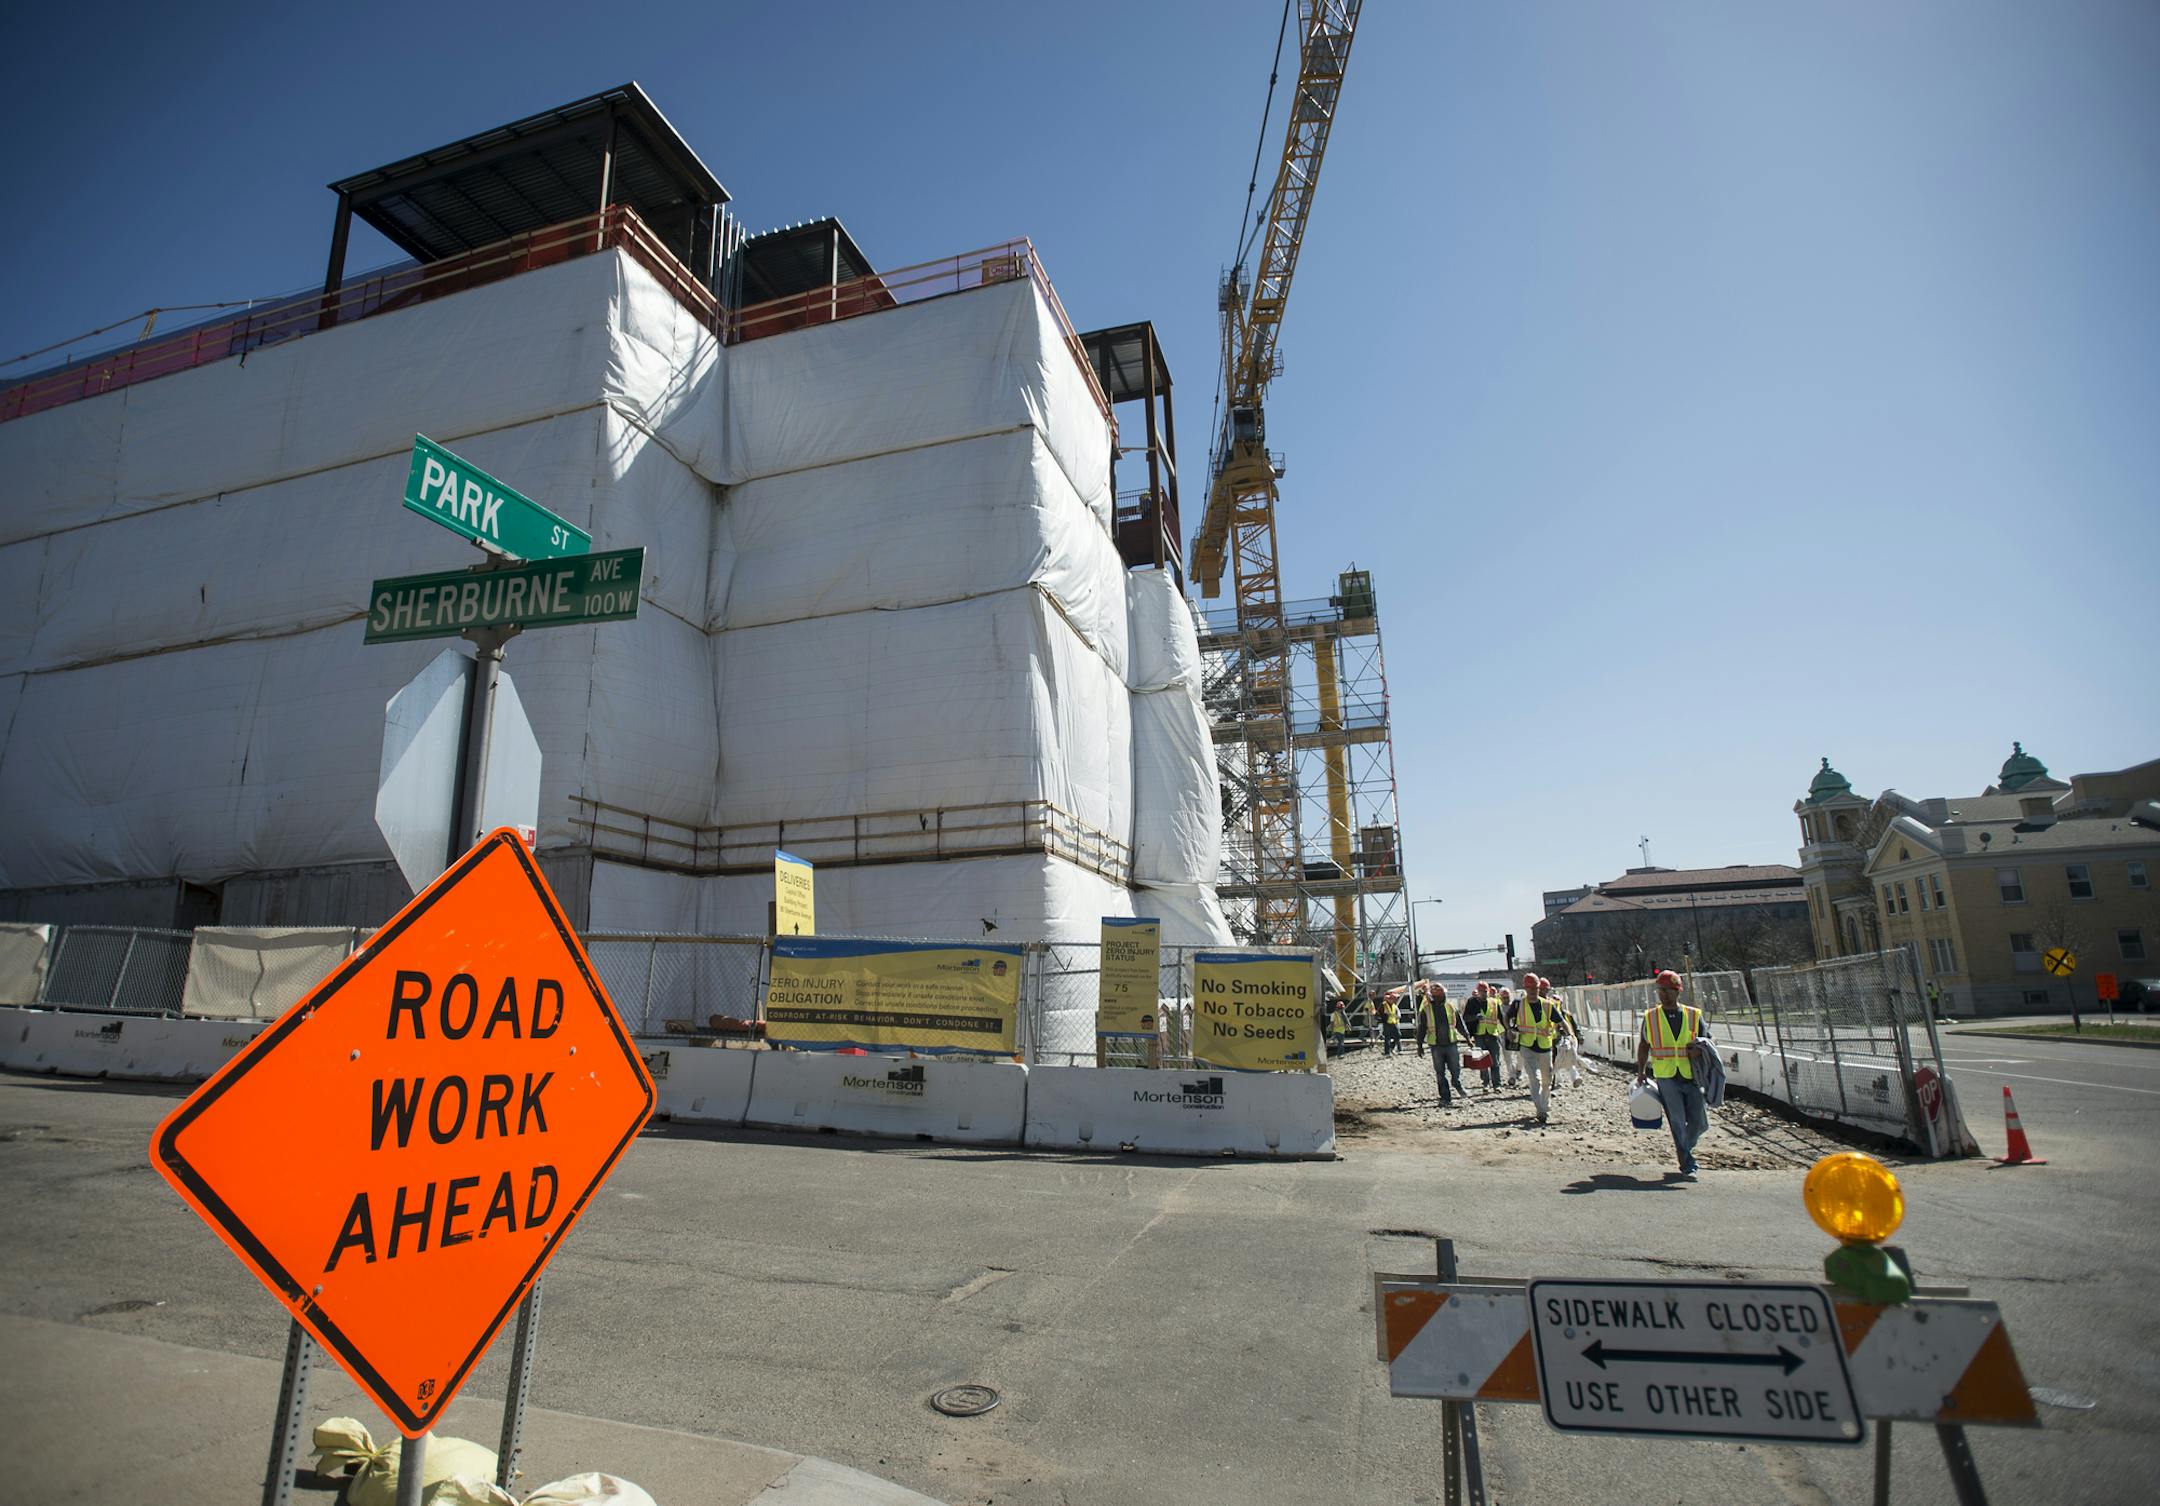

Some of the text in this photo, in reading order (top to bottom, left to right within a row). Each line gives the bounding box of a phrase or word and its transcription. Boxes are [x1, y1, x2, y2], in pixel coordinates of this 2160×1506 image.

[420, 457, 570, 549] PARK ST
[372, 558, 624, 633] SHERBURNE AVE
[780, 871, 810, 891] DELIVERIES
[771, 978, 844, 989] ZERO INJURY
[1114, 984, 1128, 992] 75
[1202, 979, 1306, 999] No Smoking
[386, 970, 564, 1040] ROAD
[770, 992, 842, 1004] OBLIGATION
[768, 1011, 809, 1019] CONFRONT
[904, 1017, 929, 1025] DON'T
[936, 1018, 979, 1028] CONDONE
[1203, 1001, 1304, 1018] No Tobacco
[1213, 1022, 1295, 1040] No Seeds
[1257, 1056, 1306, 1065] Mortenson
[843, 1076, 923, 1091] Mortenson
[1916, 1079, 1937, 1108] TOP
[1134, 1091, 1223, 1104] Mortenson
[371, 1072, 554, 1151] WORK
[323, 1165, 558, 1273] AHEAD
[1547, 1298, 1819, 1332] SIDEWALK CLOSED
[1566, 1381, 1836, 1422] USE OTHER SIDE
